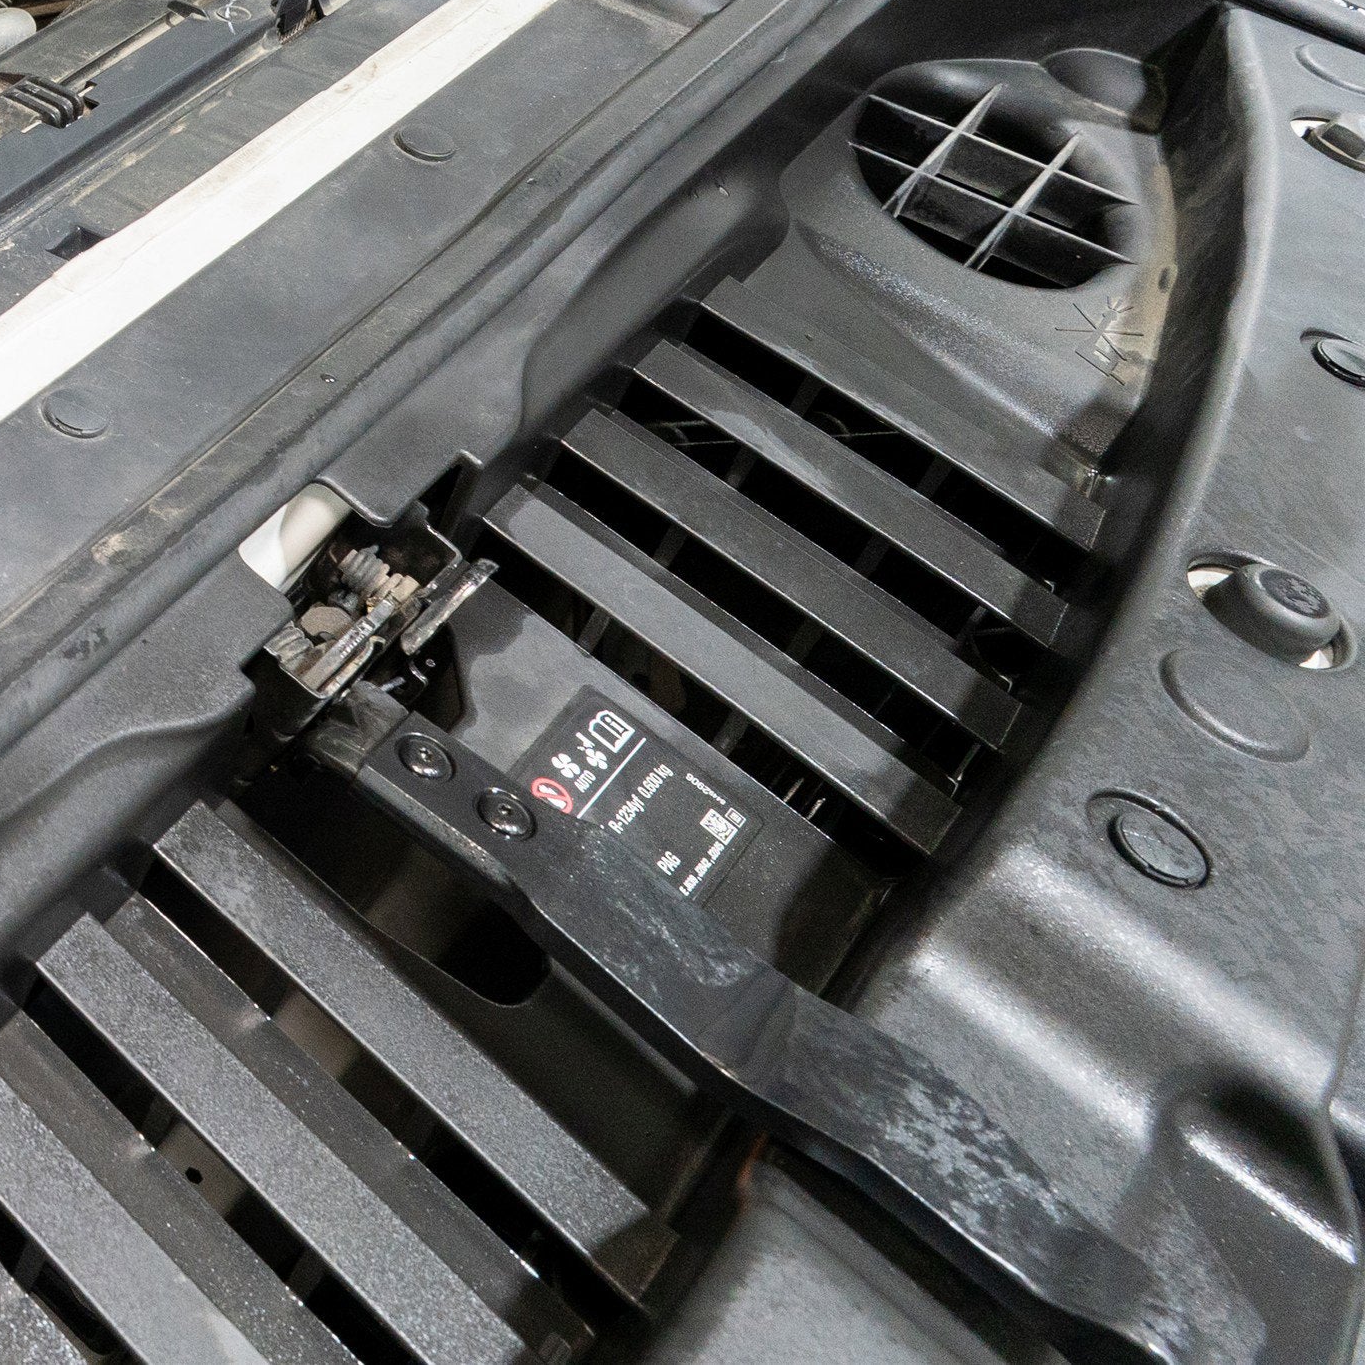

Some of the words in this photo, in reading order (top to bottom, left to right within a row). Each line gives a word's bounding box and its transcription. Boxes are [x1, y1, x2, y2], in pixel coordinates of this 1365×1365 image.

[574, 770, 596, 793] AUTO
[608, 794, 645, 834] R-1234yf
[637, 771, 664, 798] 0.600
[654, 763, 674, 781] kg
[657, 850, 681, 875] PAG
